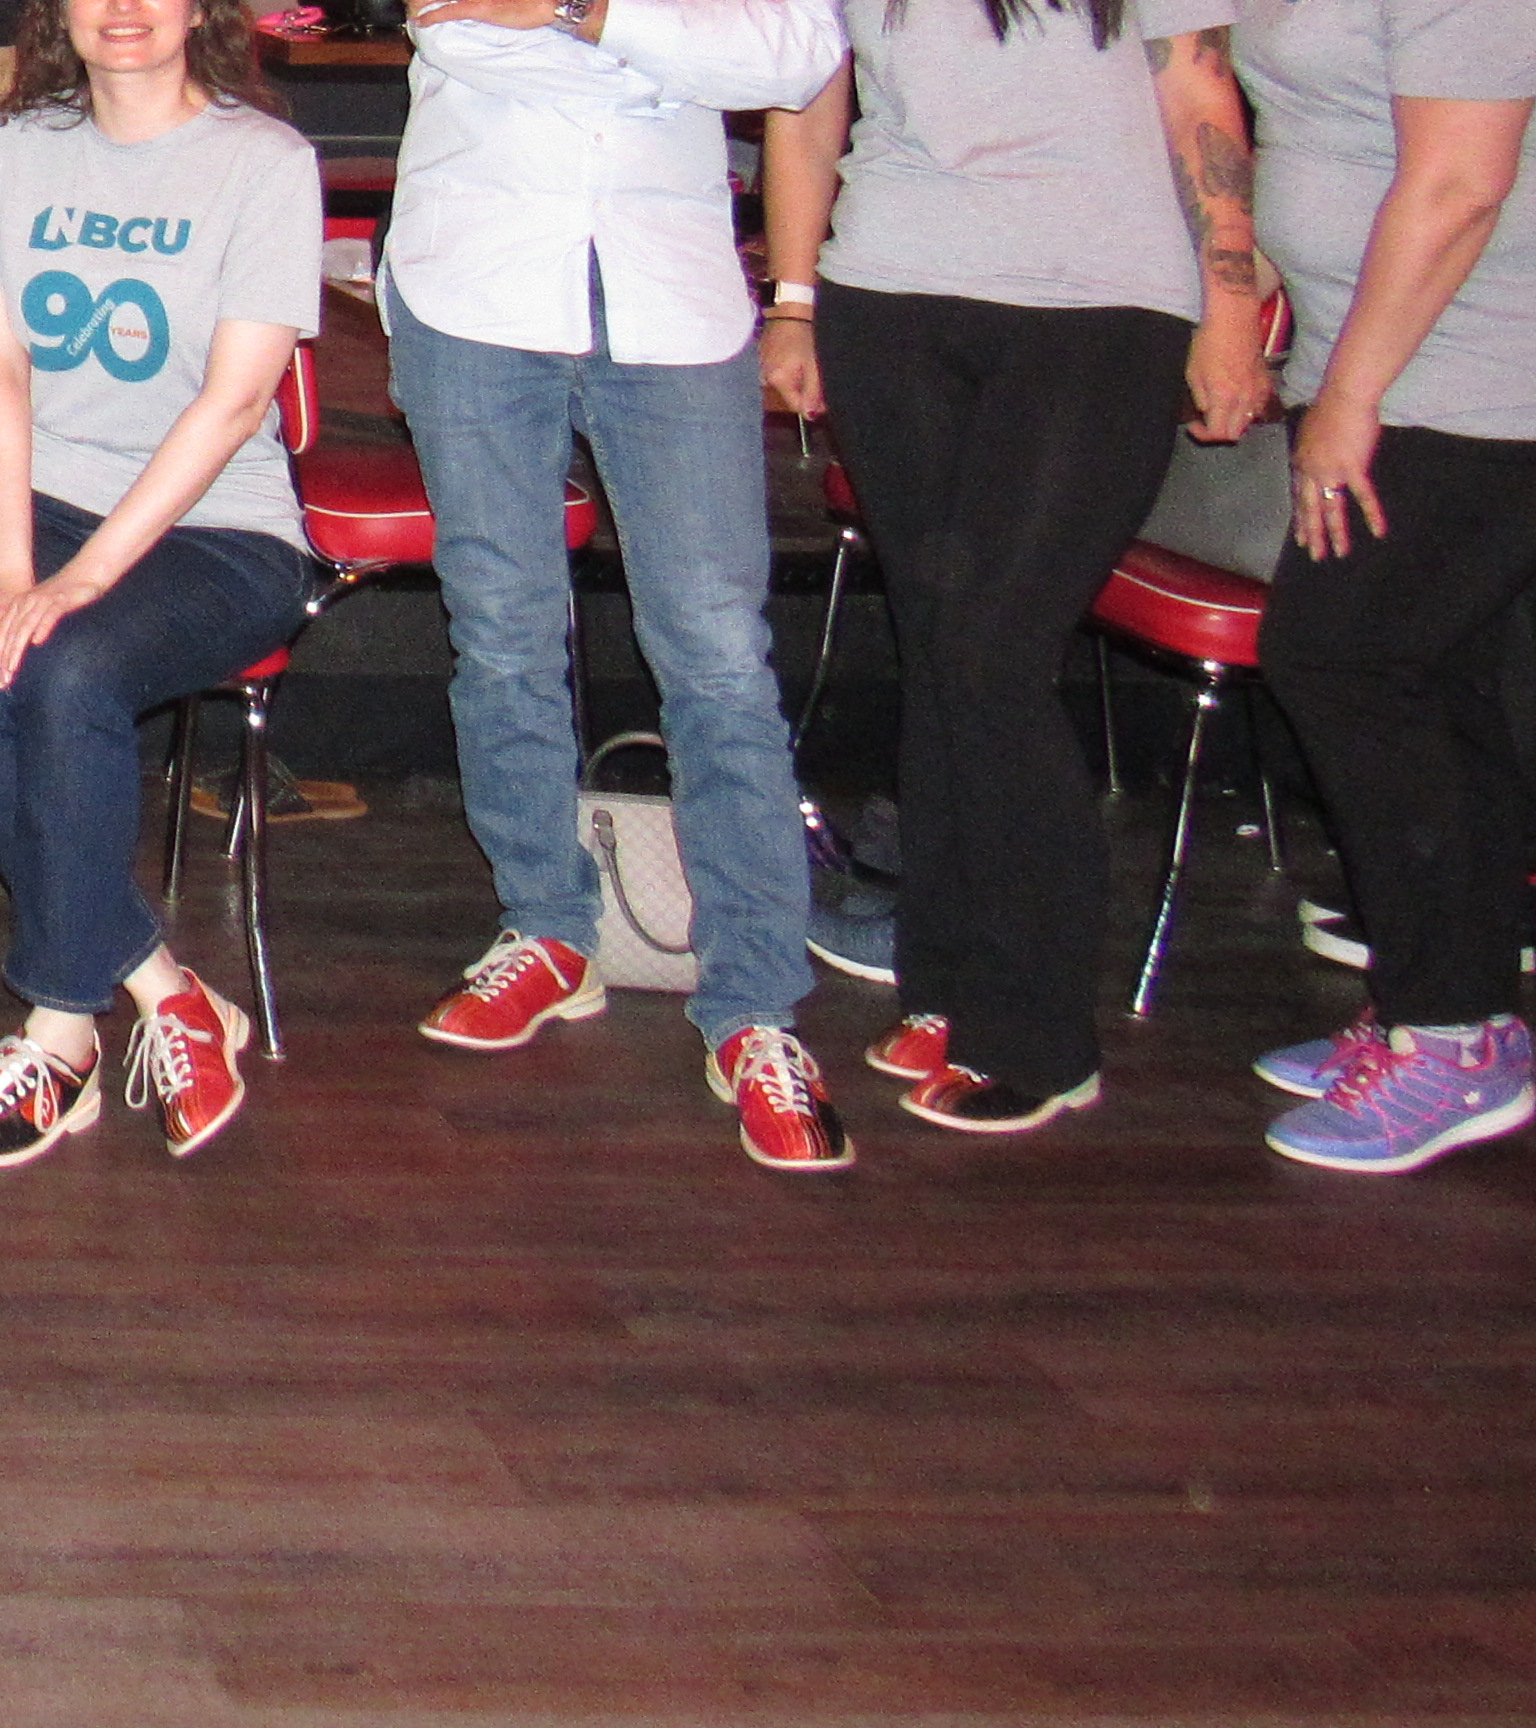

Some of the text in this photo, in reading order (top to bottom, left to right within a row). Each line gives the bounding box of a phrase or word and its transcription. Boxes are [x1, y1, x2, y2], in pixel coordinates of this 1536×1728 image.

[20, 269, 170, 383] 90
[65, 297, 117, 358] Celebrating
[111, 327, 148, 340] YEARS
